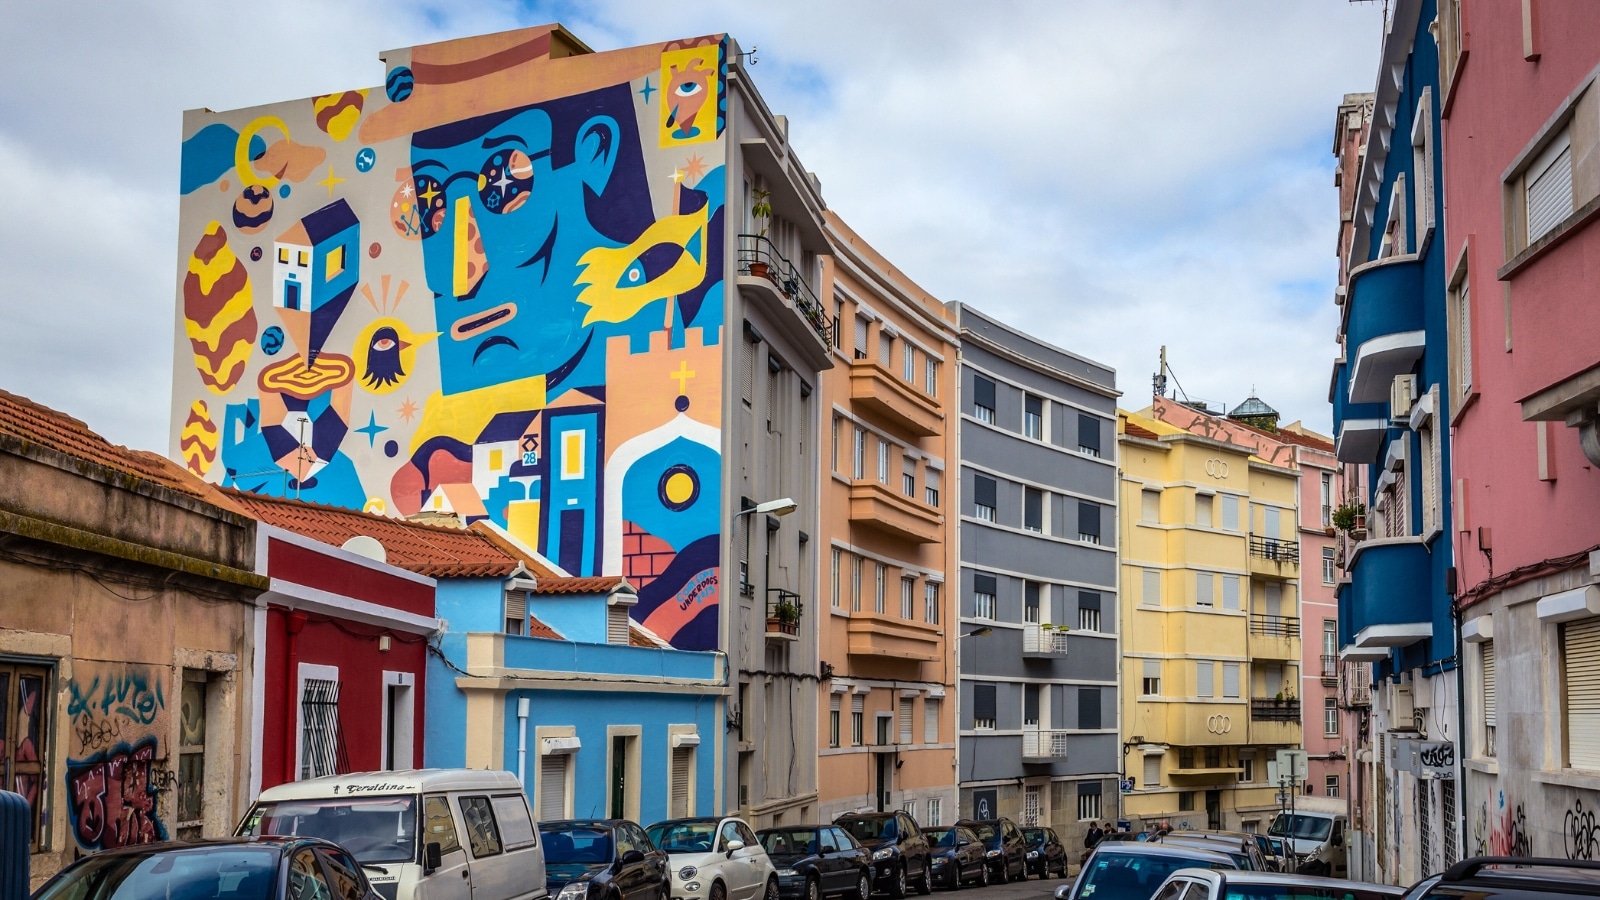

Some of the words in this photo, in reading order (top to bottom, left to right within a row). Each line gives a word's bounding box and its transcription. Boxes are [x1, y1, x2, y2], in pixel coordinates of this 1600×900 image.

[523, 452, 537, 465] 28
[680, 576, 718, 610] UNDERDOGS
[346, 782, 405, 794] Geraldina
